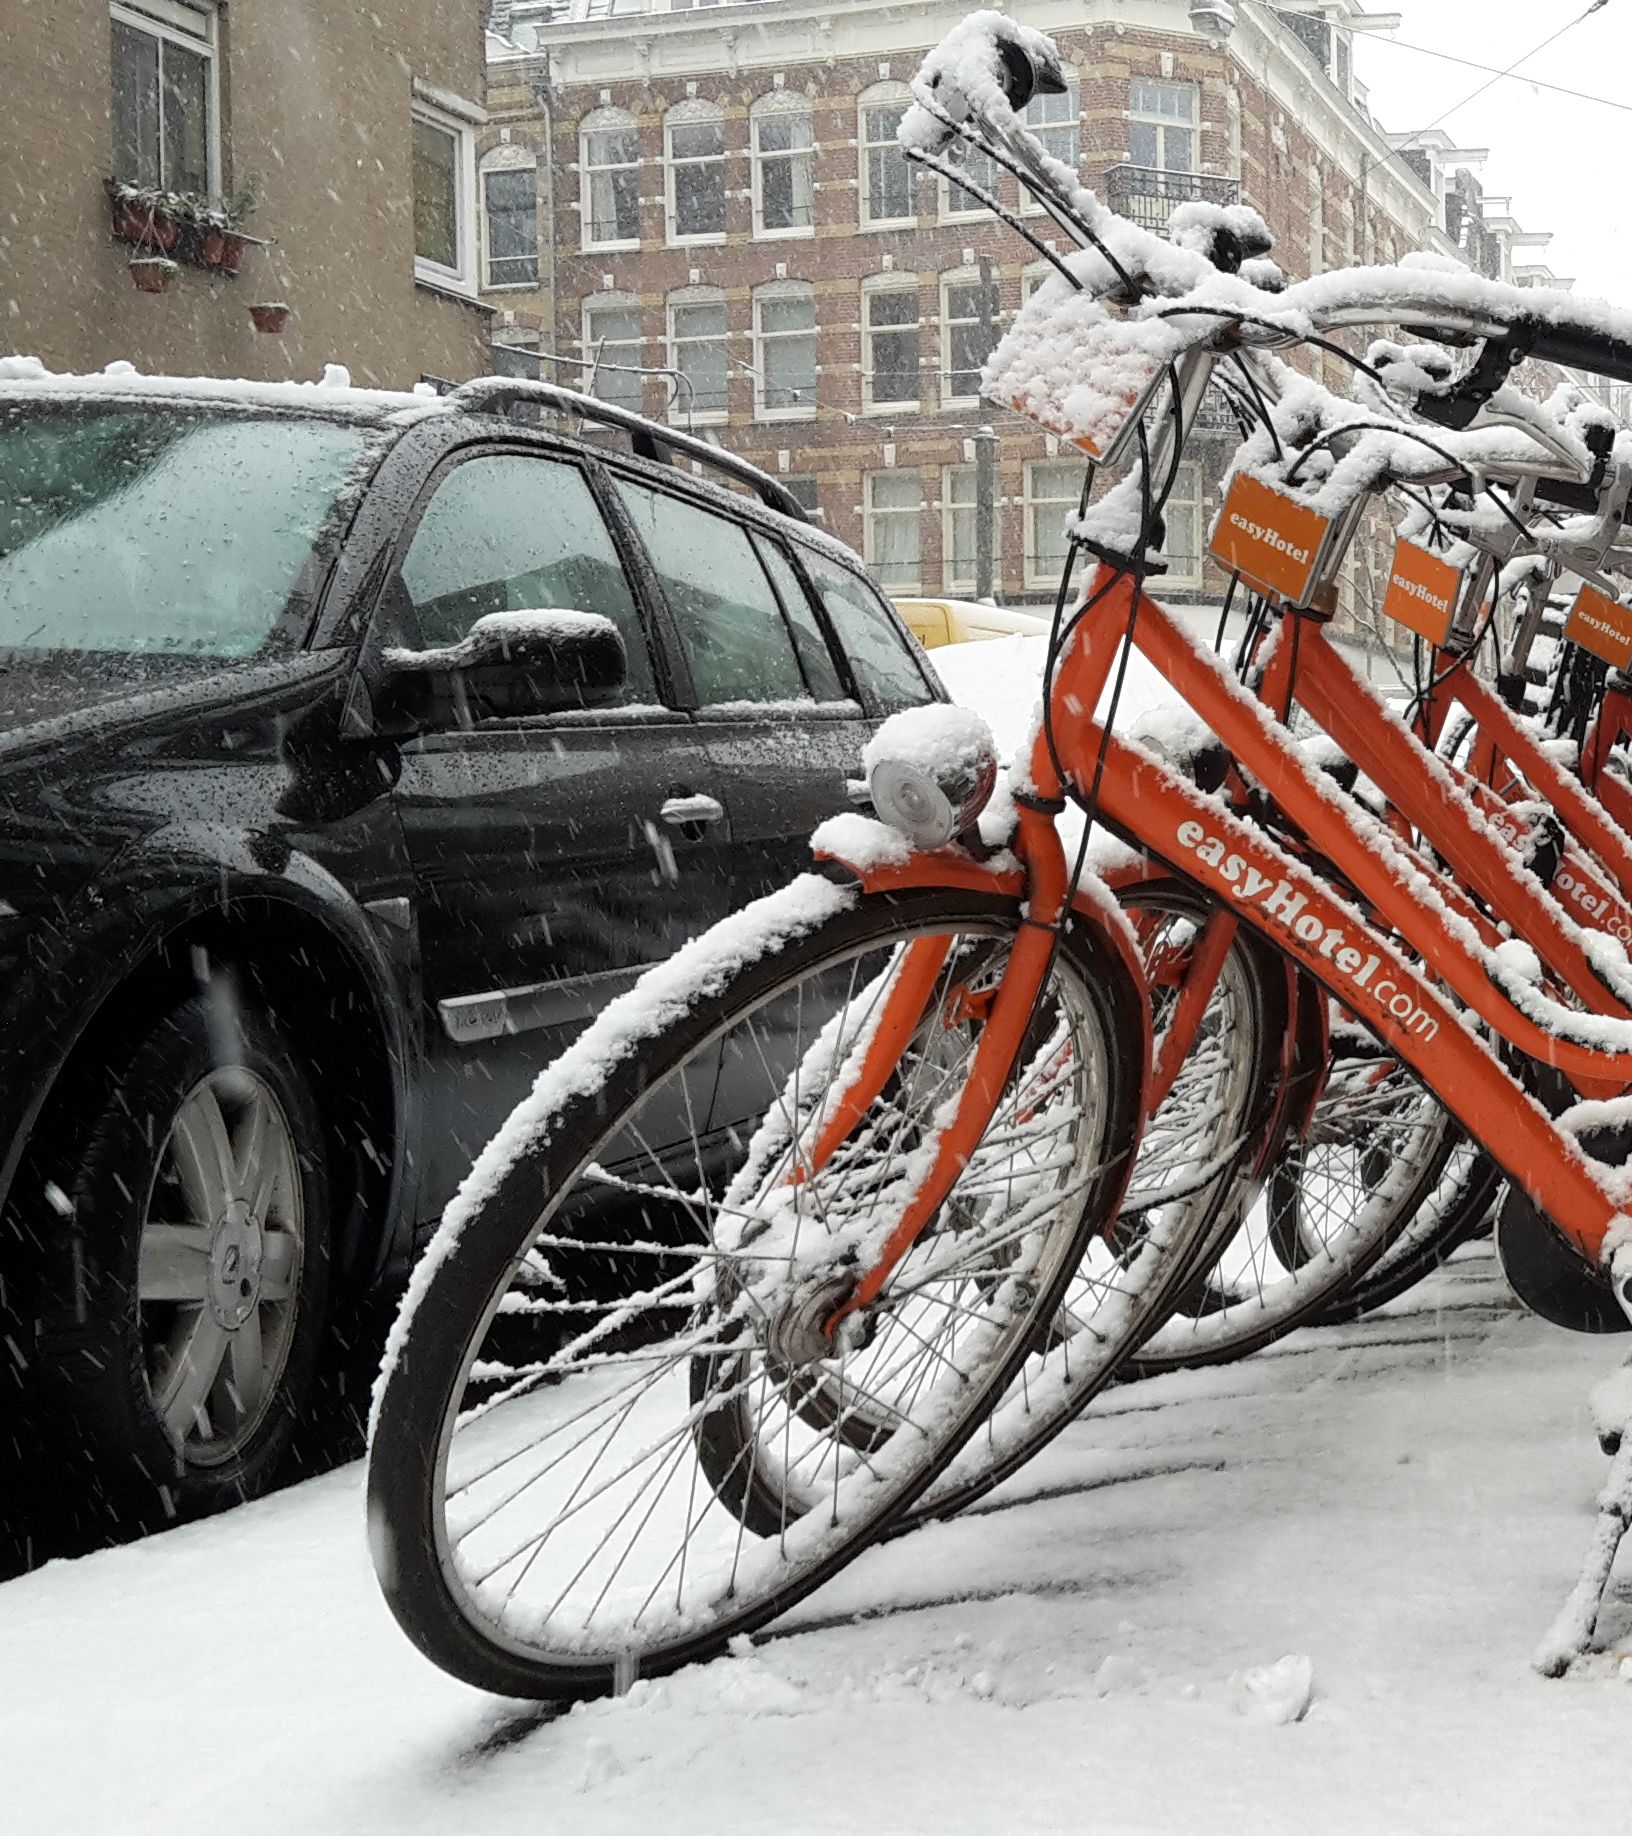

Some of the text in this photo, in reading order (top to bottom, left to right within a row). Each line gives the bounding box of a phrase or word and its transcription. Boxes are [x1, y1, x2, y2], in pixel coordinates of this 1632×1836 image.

[1229, 511, 1310, 565] easyHotel
[1392, 573, 1449, 613] easyHotel
[1577, 610, 1632, 646] easyHotel
[1176, 820, 1441, 1042] easyHotel.com
